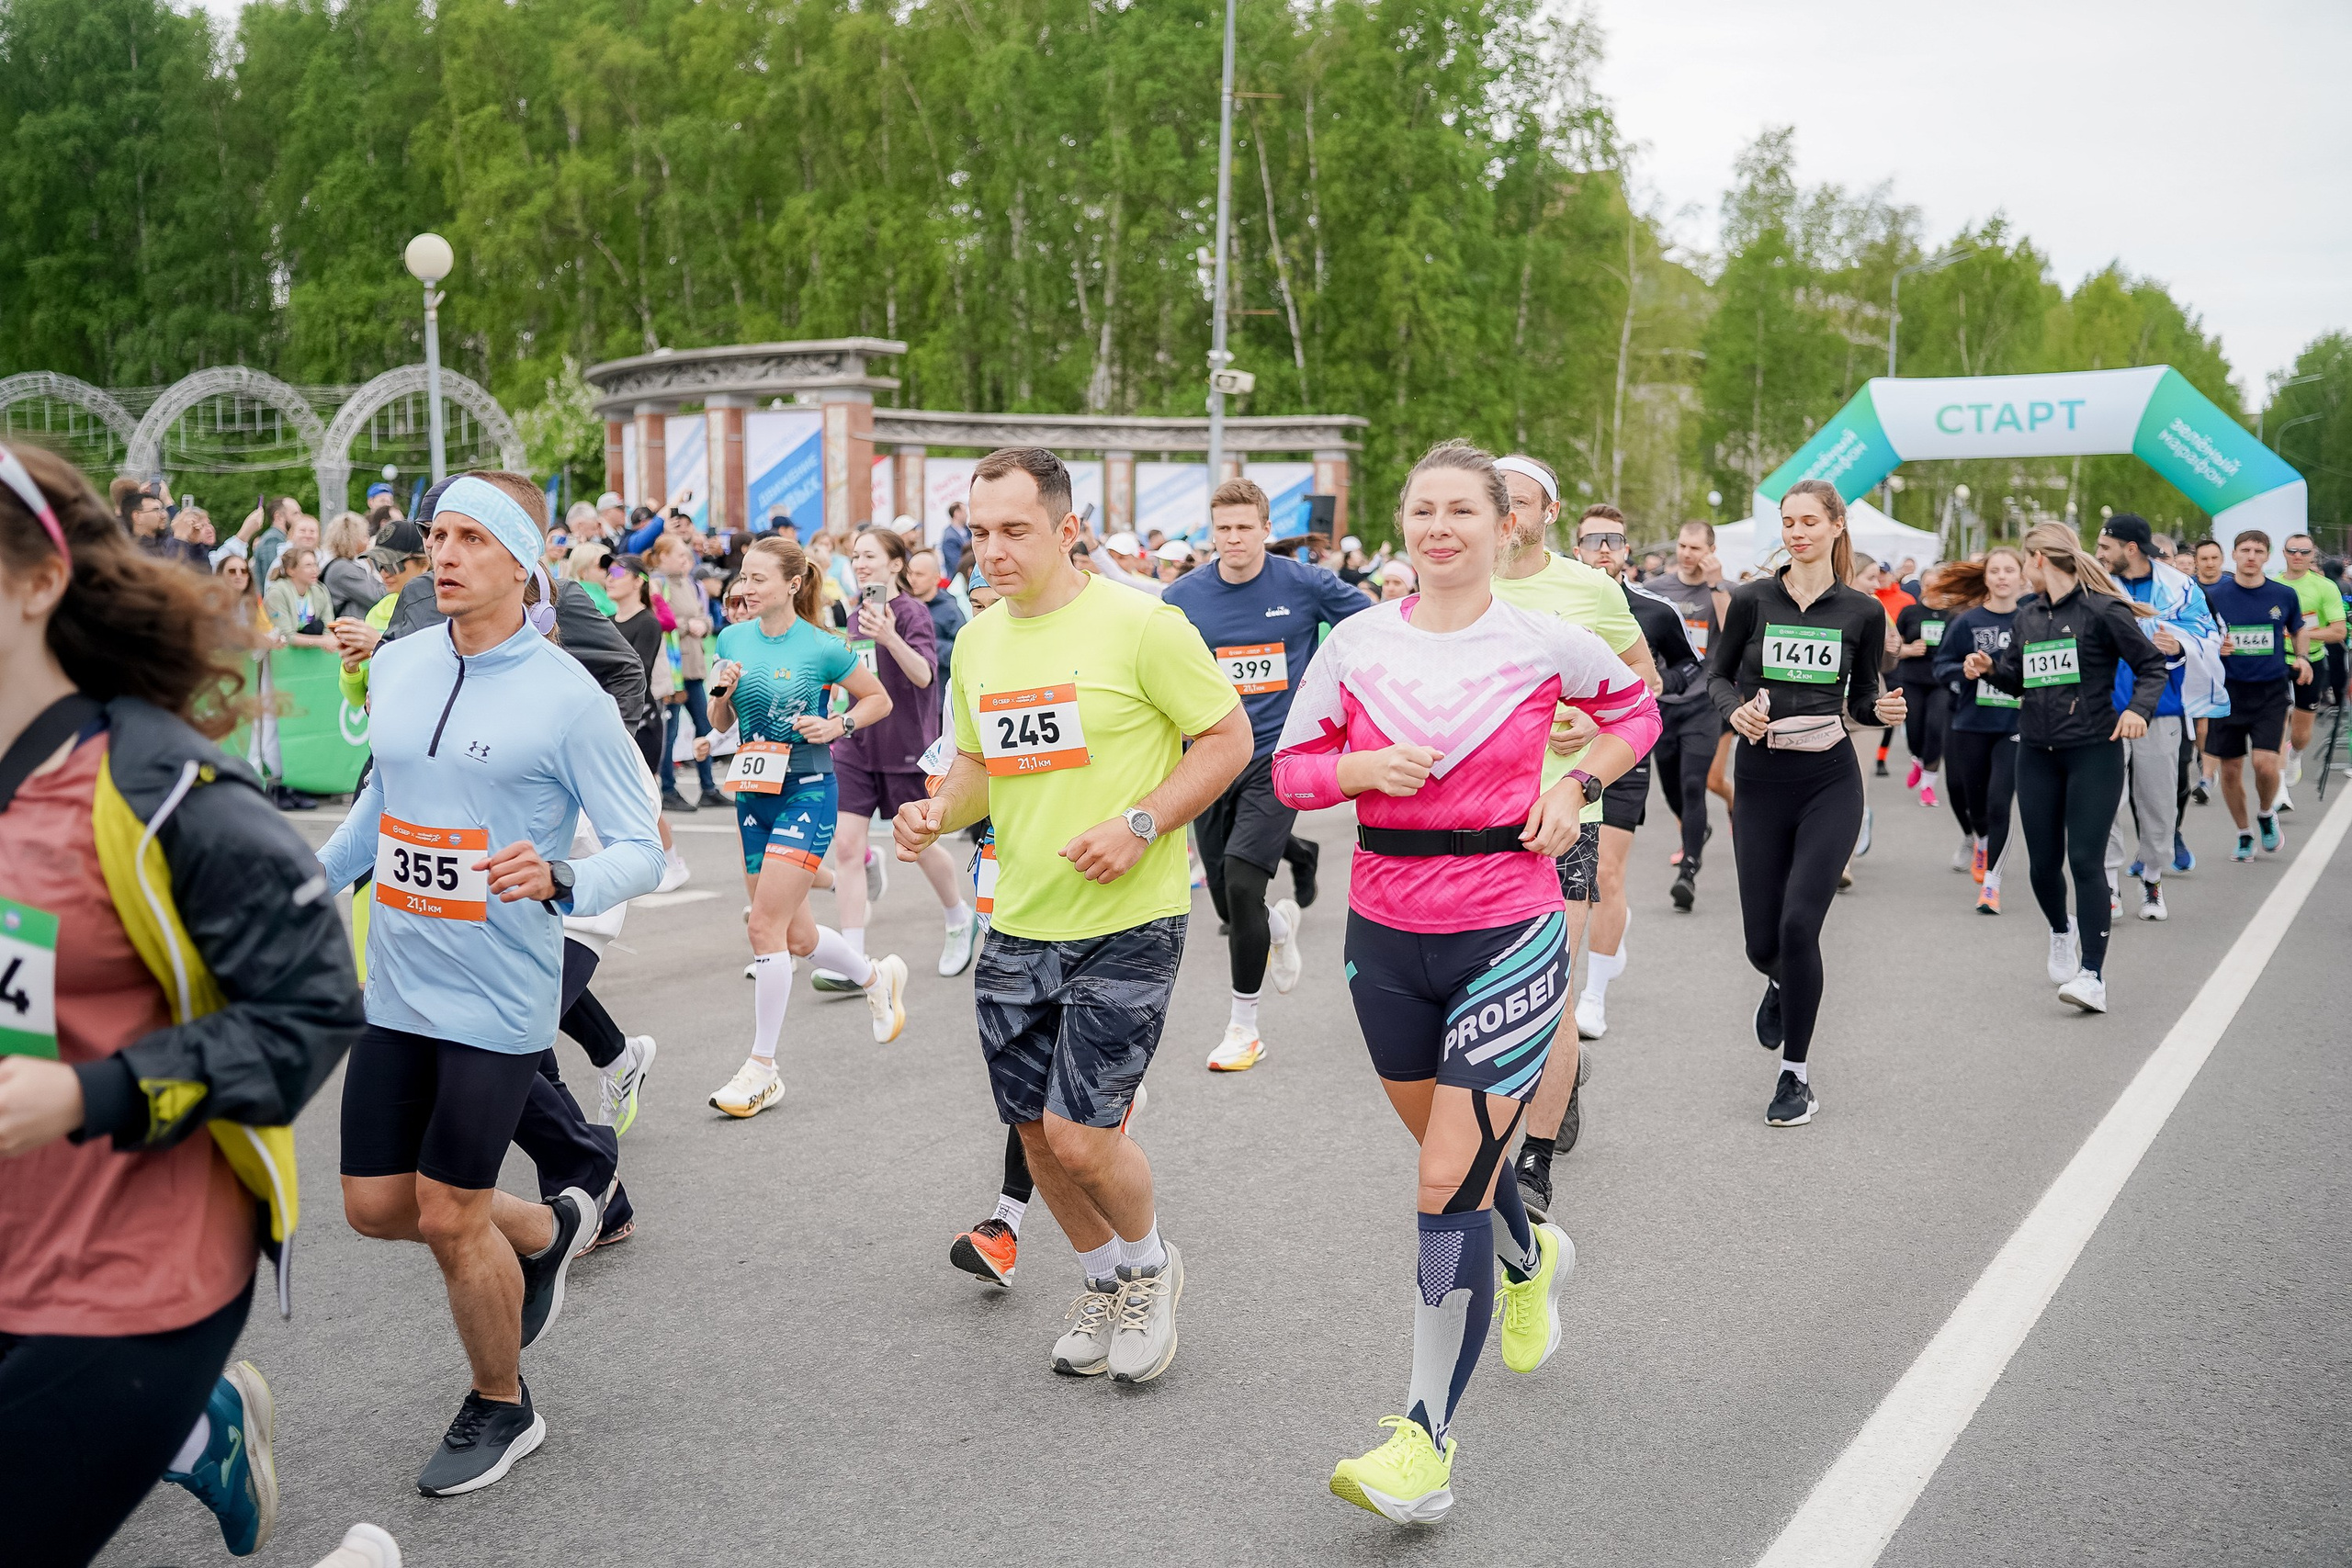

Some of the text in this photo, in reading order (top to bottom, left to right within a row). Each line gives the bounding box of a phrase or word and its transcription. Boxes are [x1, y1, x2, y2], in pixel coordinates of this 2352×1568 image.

[1936, 400, 2086, 434] СТАРТ
[2158, 428, 2226, 488] марафон
[2169, 417, 2242, 477] зелёный
[1820, 440, 1868, 483] рафон
[1772, 642, 1832, 665] 1416
[2030, 653, 2071, 672] 1314
[1232, 660, 1271, 679] 399
[1787, 670, 1802, 680] 4,2
[998, 711, 1060, 750] 245
[1796, 731, 1830, 746] DEMIX
[741, 757, 765, 774] 50
[1017, 756, 1038, 771] 21,1
[393, 848, 458, 891] 355
[406, 896, 426, 912] 21,1
[1443, 961, 1559, 1063] PROБЕГ
